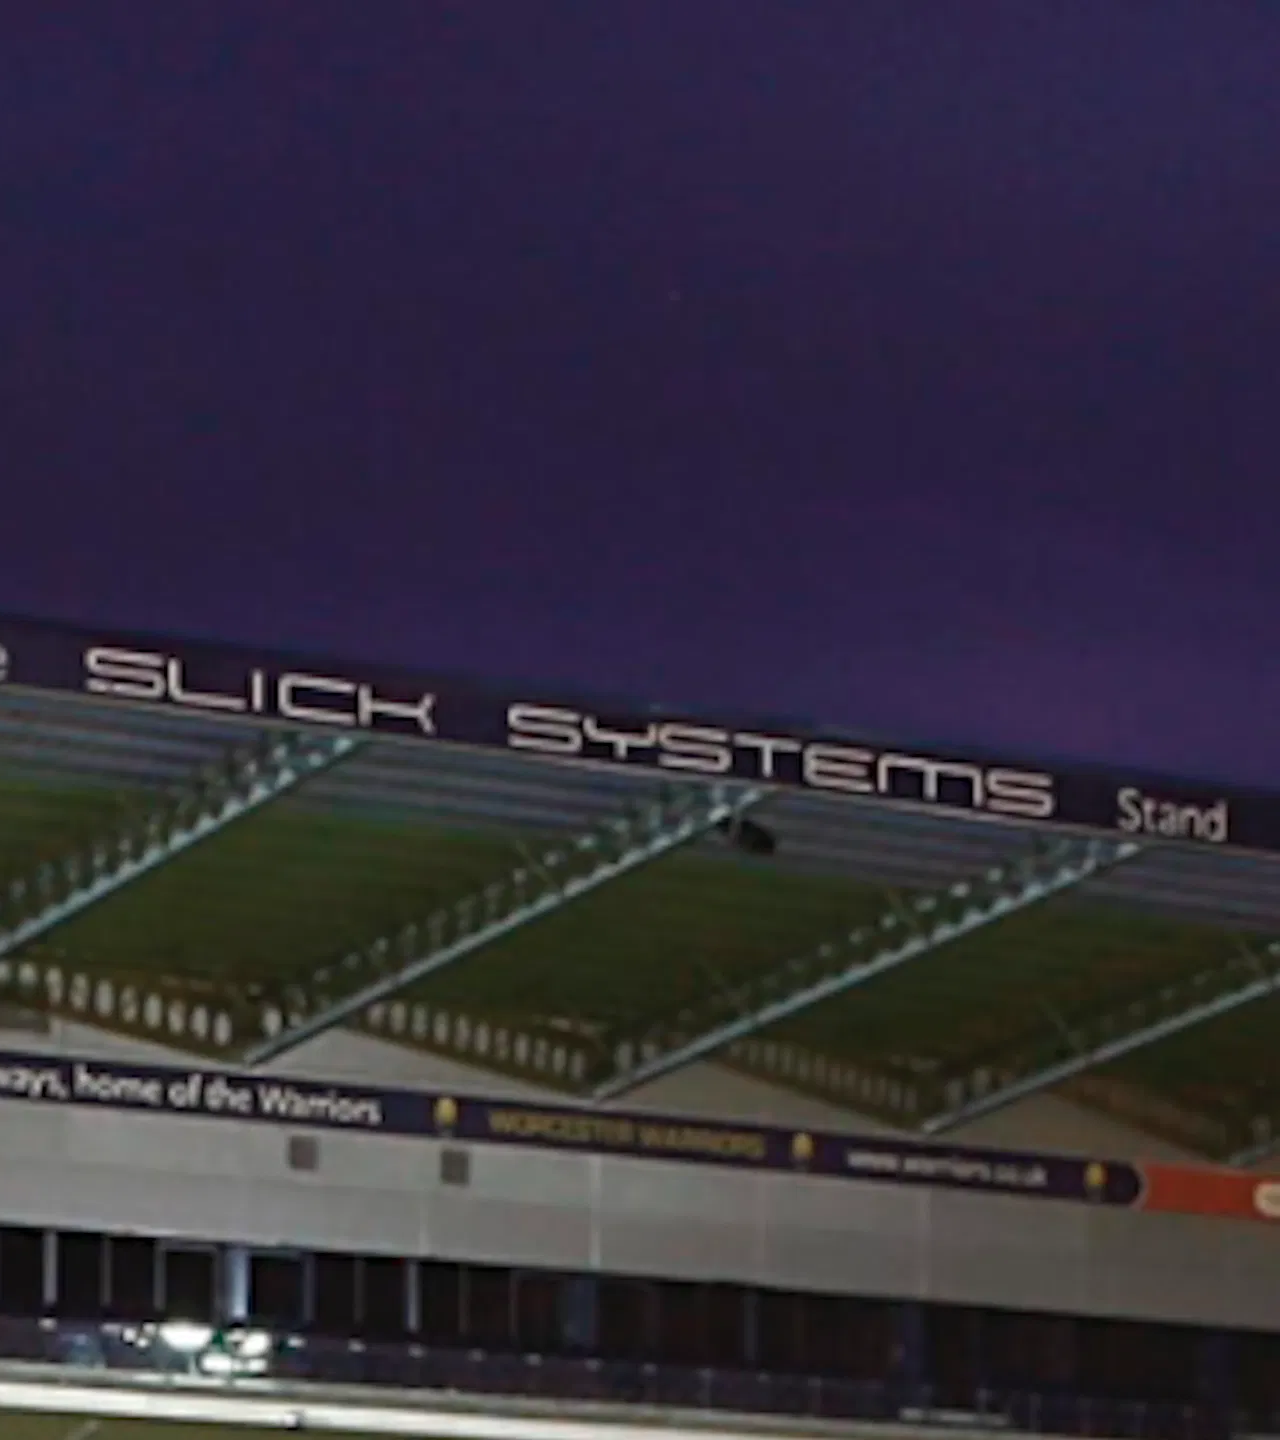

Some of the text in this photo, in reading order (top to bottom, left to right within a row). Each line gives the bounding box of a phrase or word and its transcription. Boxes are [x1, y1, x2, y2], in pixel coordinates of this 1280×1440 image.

[83, 646, 437, 735] SLICK
[506, 701, 1057, 818] SYSTEMS
[1117, 786, 1228, 843] Stand
[76, 1063, 162, 1106] home
[168, 1072, 204, 1108] of
[204, 1074, 251, 1113] the
[258, 1083, 383, 1128] Warriors
